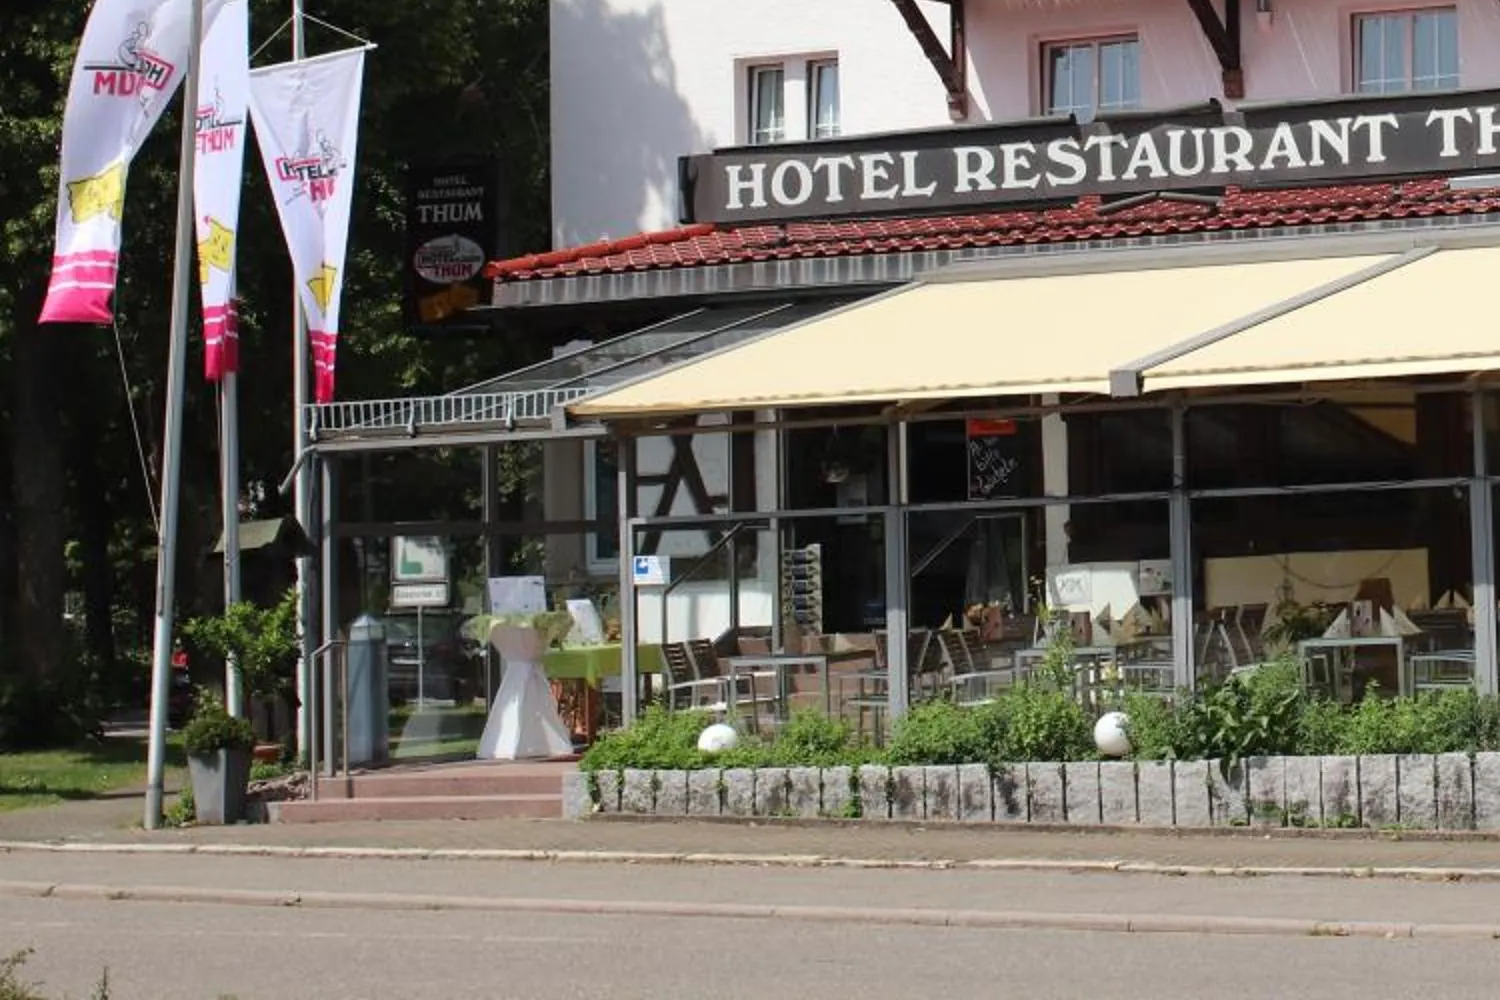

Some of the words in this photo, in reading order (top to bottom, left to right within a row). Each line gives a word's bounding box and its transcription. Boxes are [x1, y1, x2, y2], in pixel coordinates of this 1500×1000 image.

[725, 150, 938, 210] HOTEL
[953, 112, 1399, 193] RESTAURANT
[416, 202, 483, 223] THUM
